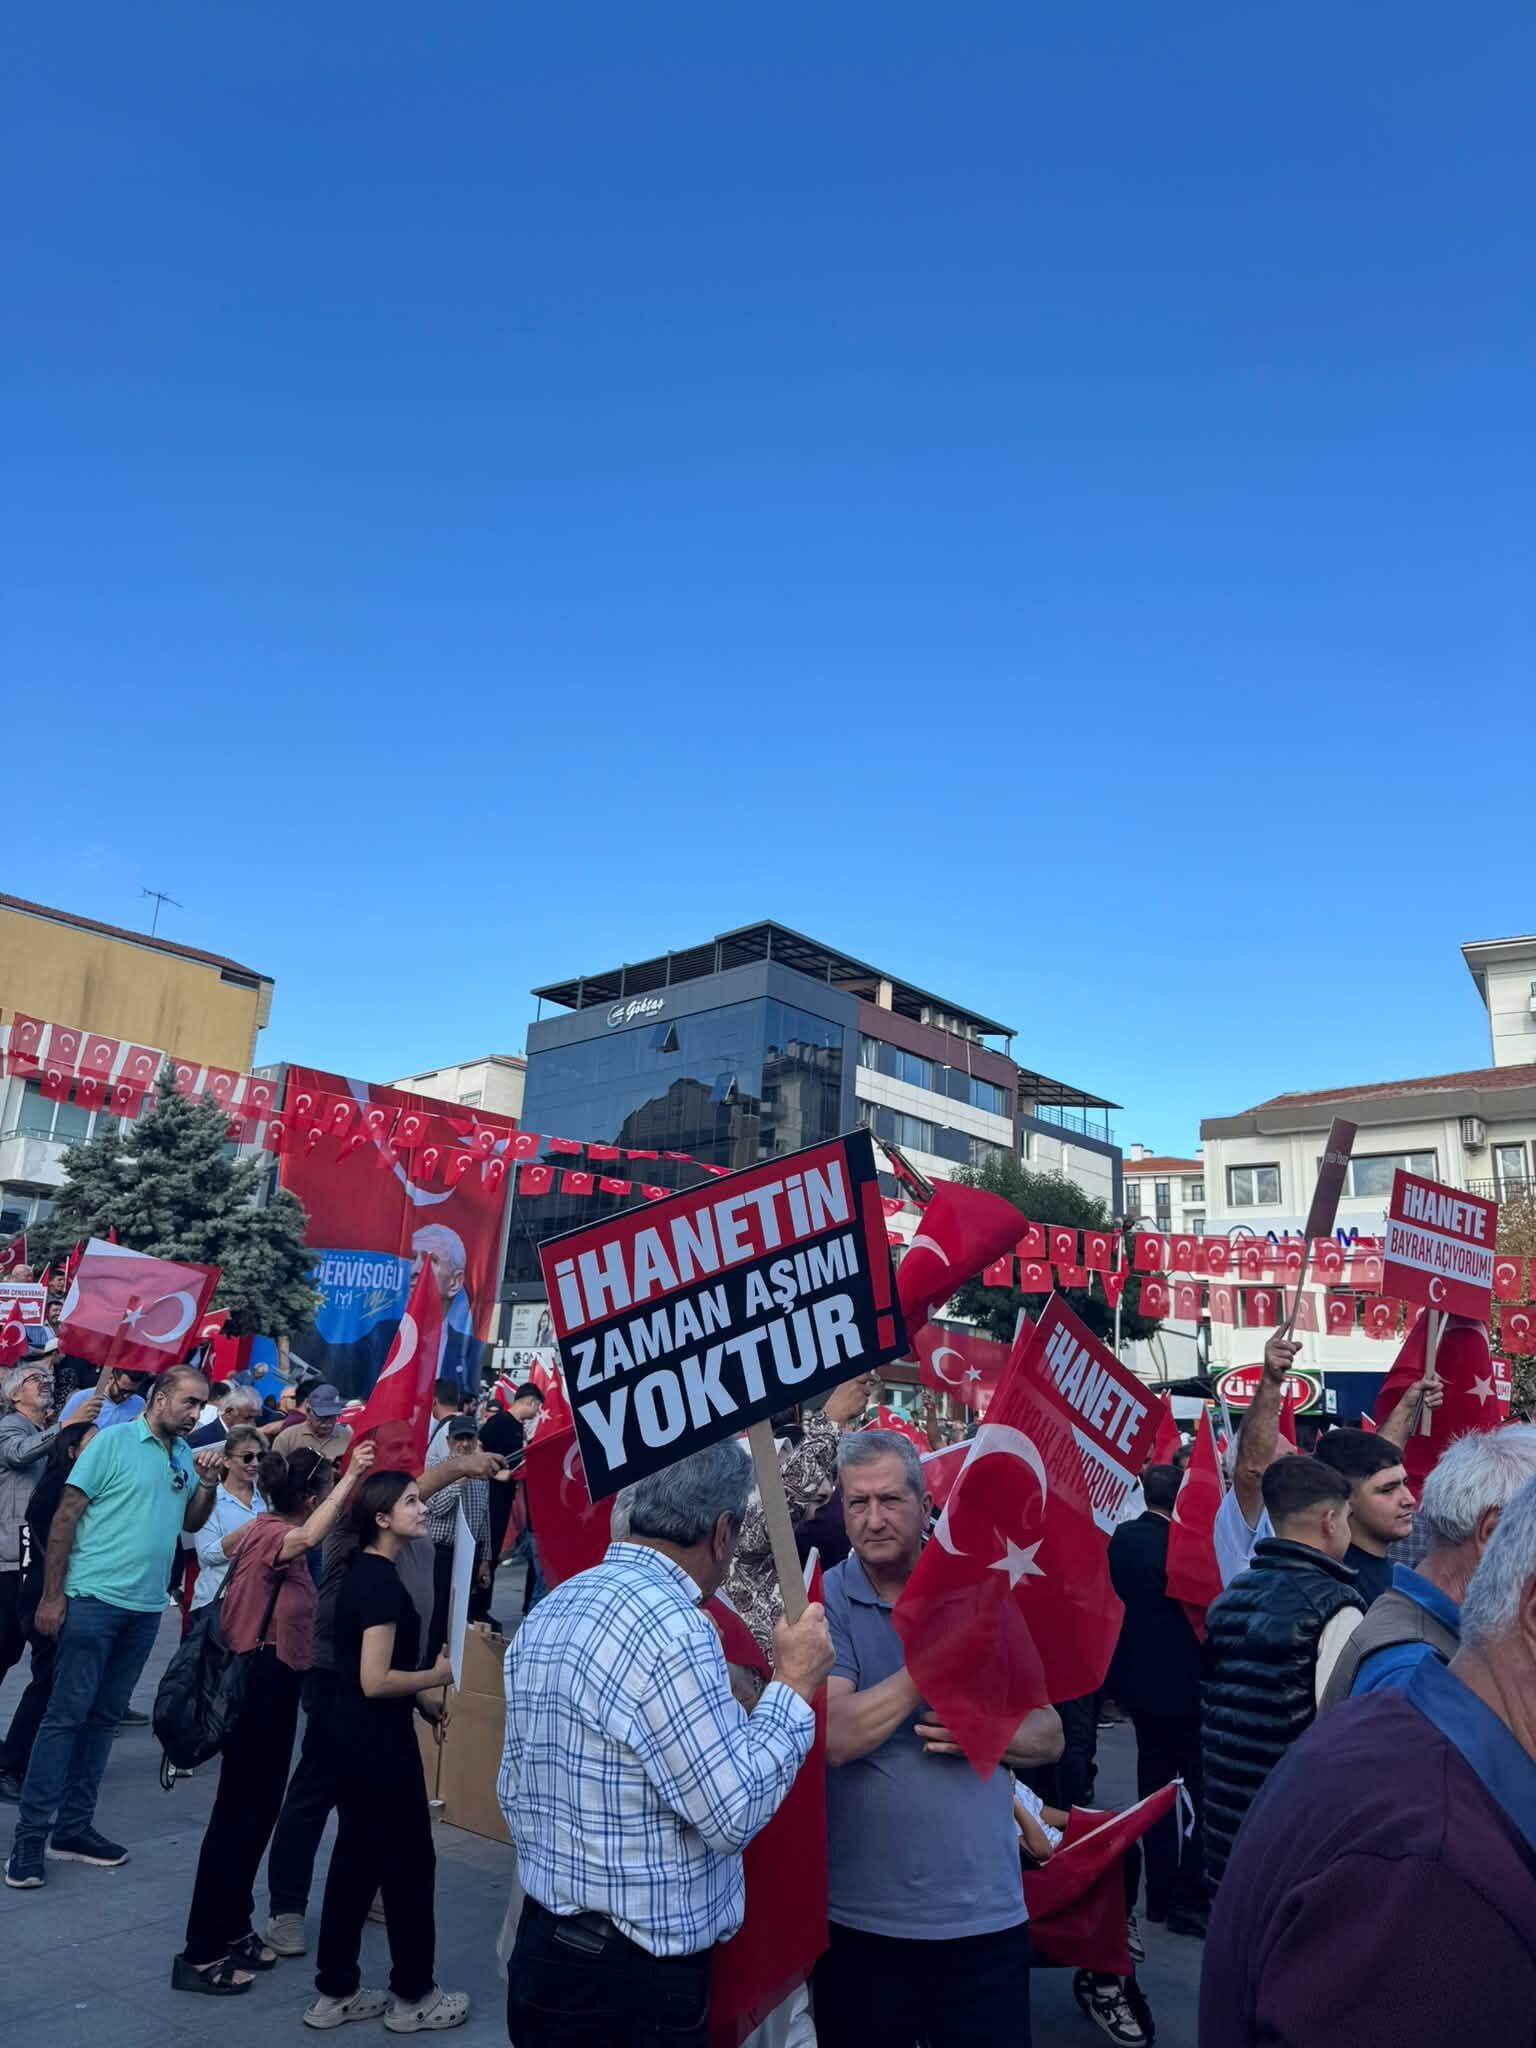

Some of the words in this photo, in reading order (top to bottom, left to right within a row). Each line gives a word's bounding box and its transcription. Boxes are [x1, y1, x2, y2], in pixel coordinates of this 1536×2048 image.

[570, 1284, 731, 1392] ZAMAN
[745, 1232, 860, 1318] AŞIMI
[1390, 1226, 1434, 1265] BAYRAK
[1434, 1240, 1492, 1281] AÇIYORUM!
[577, 1293, 865, 1471] YOKTUR
